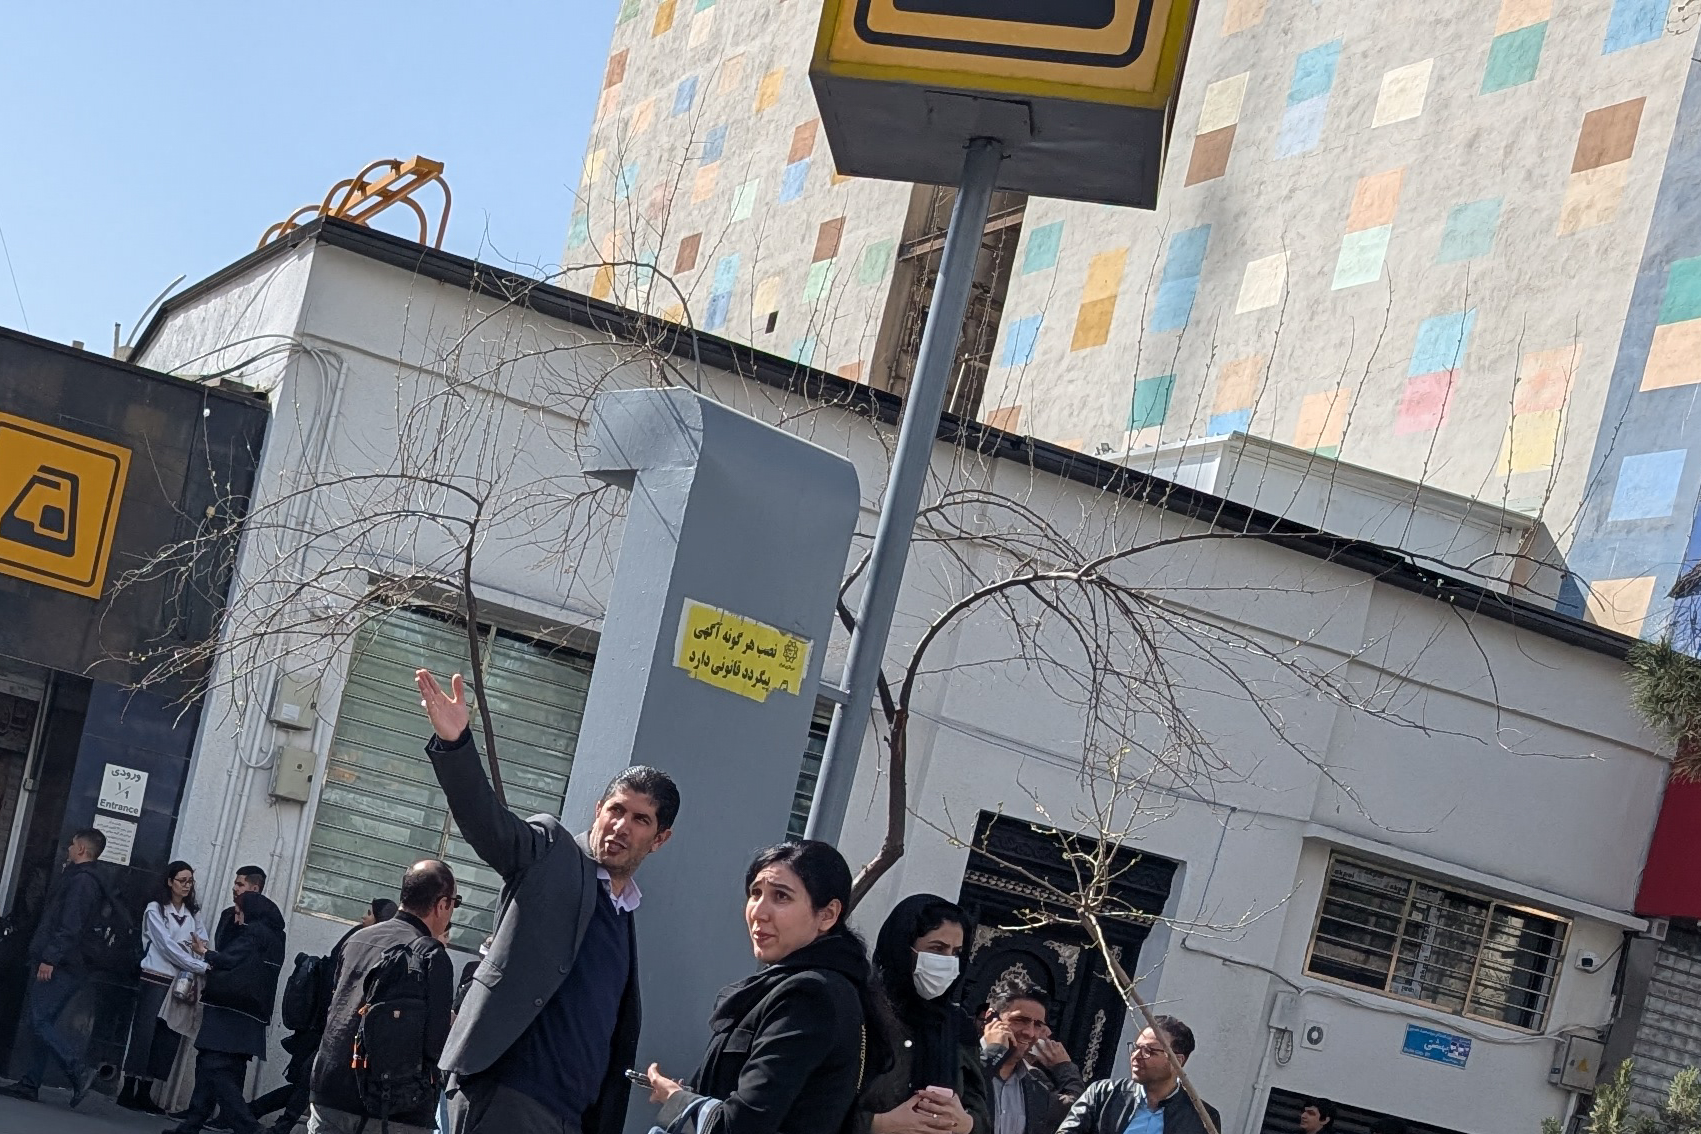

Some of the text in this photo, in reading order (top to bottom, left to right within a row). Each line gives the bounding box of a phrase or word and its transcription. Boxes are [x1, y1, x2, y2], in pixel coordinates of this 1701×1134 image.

[693, 621, 777, 658] نصب هر گونه آگهی
[689, 650, 711, 669] دارد
[711, 656, 742, 678] قانونی
[111, 768, 141, 783] ورودی
[99, 798, 139, 815] Entrance
